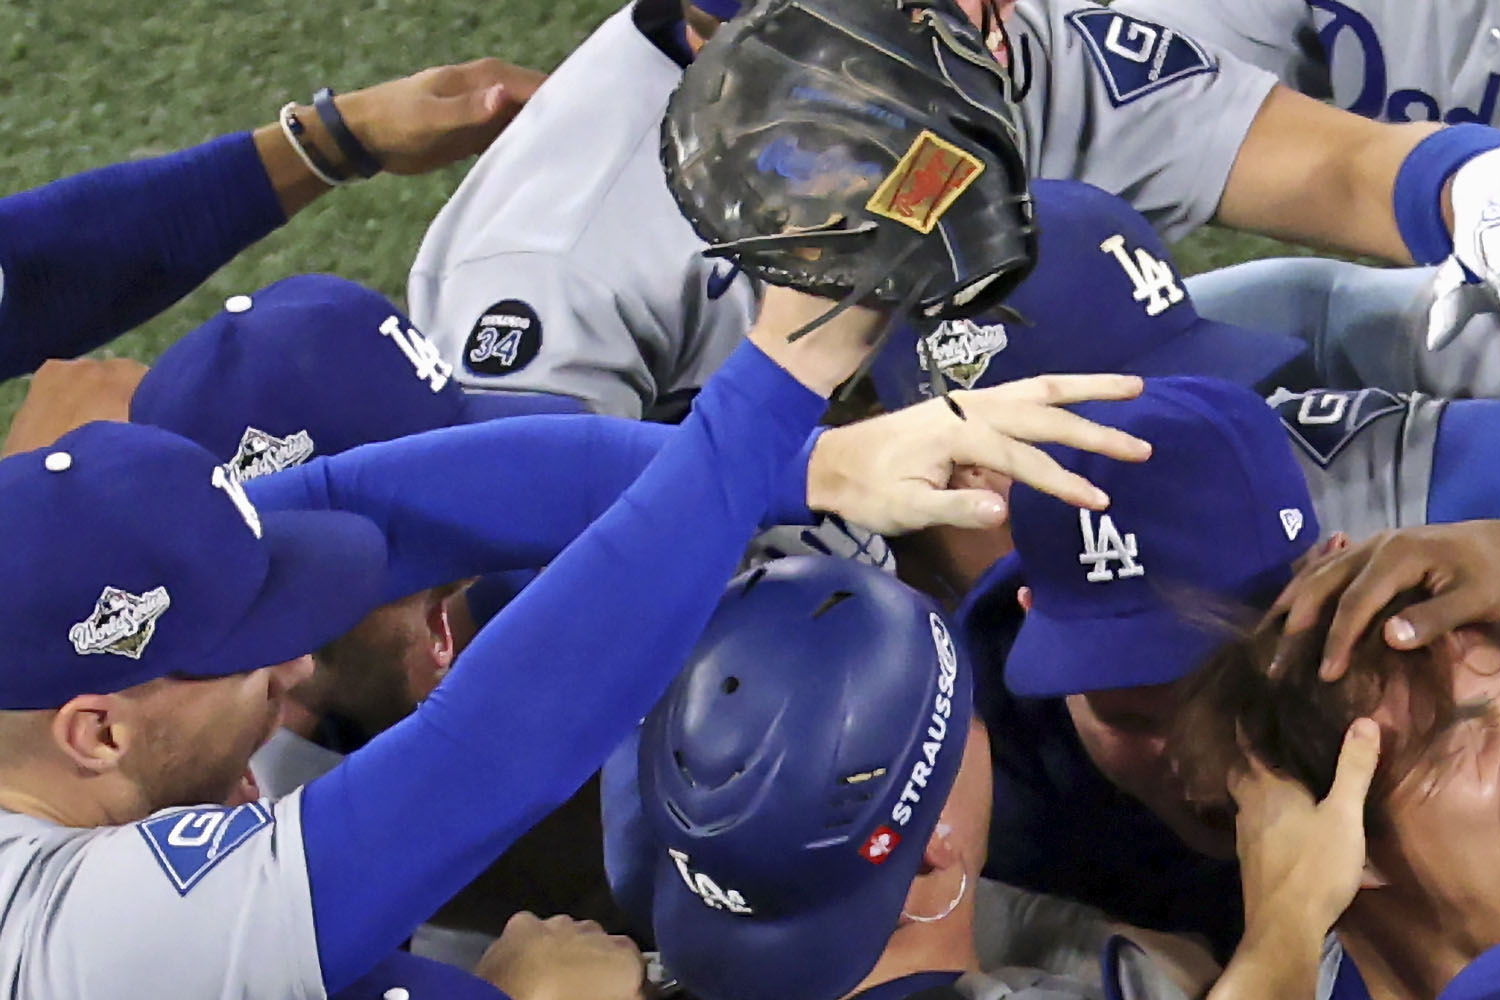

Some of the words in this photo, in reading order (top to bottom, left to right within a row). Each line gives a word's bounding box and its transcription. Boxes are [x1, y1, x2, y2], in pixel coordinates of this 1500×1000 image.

[1100, 234, 1185, 316] LA
[379, 315, 453, 392] LA
[470, 327, 523, 367] 34
[1079, 508, 1144, 581] LA
[892, 673, 954, 827] STRAUSS
[668, 848, 753, 915] LA
